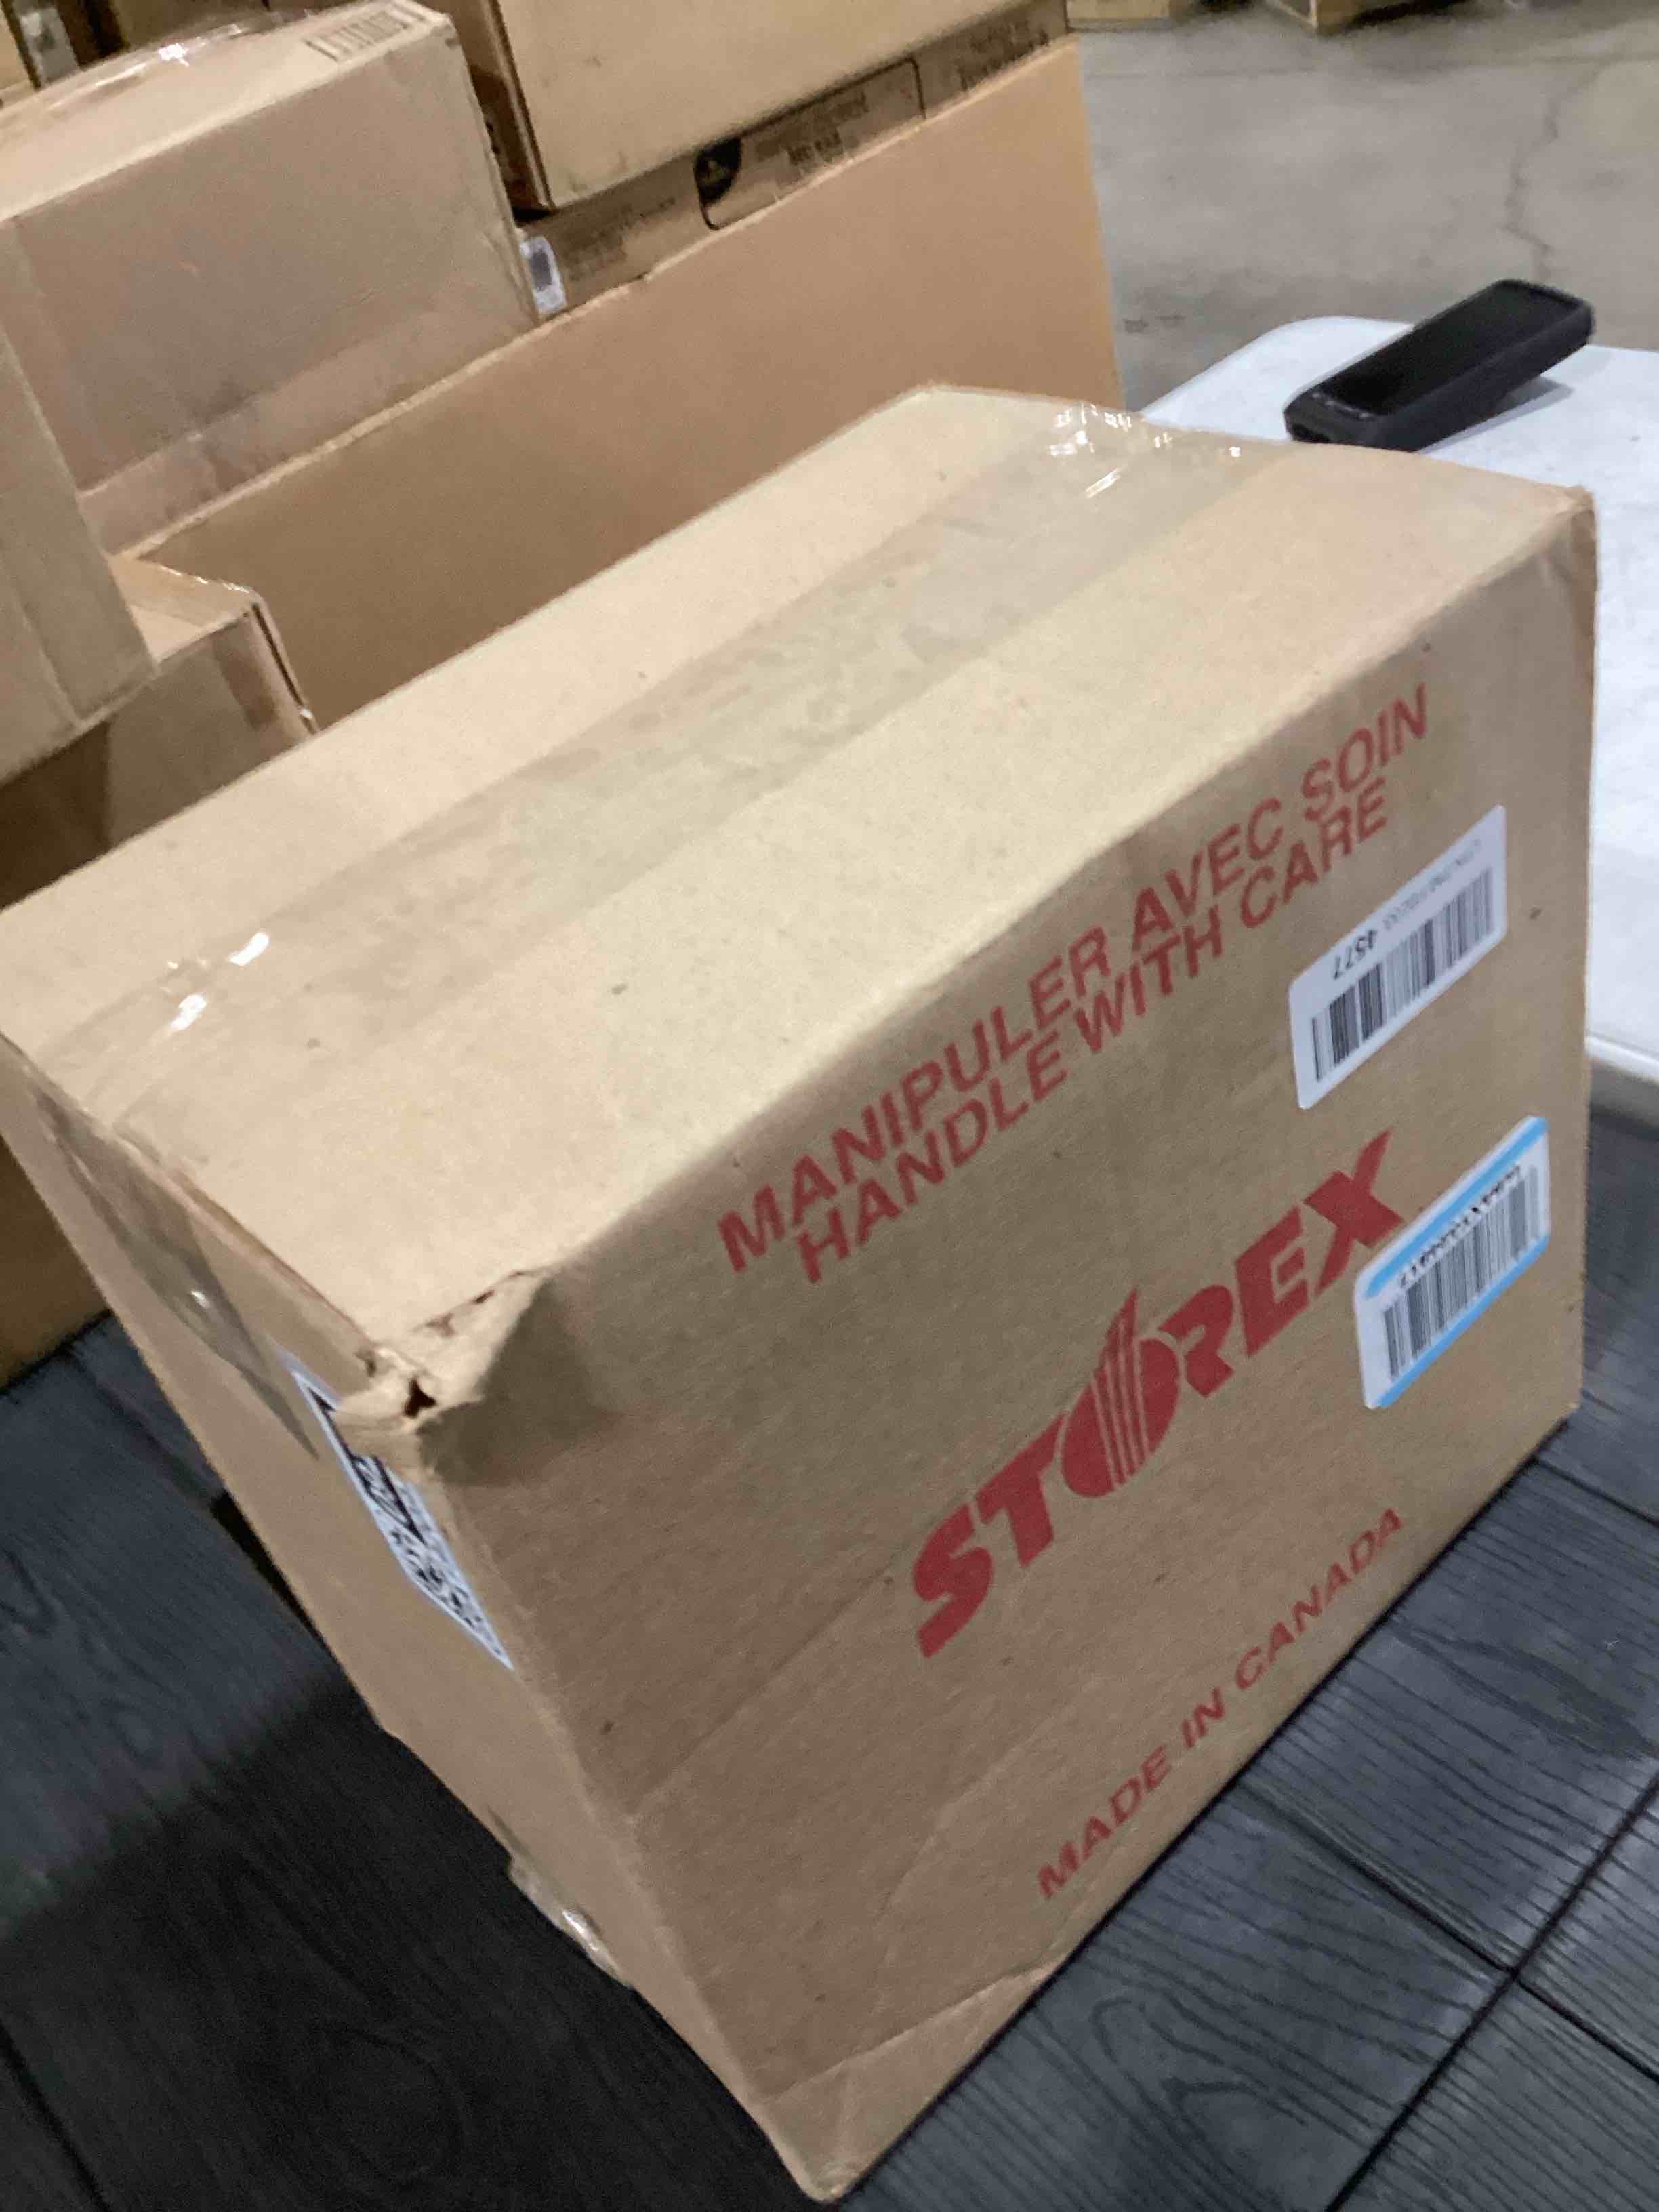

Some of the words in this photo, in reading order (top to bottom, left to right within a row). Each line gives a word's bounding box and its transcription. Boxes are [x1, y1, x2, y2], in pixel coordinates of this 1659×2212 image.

[718, 928, 1109, 1271] MANIPULER
[1132, 800, 1279, 950] AVEC
[1304, 686, 1427, 819] SOIN
[798, 1034, 1066, 1281] HANDLE
[1076, 911, 1221, 1052] WITH
[1241, 779, 1386, 927] CARE
[913, 1129, 1404, 1657] STOREX
[1038, 1746, 1171, 1898] MADE
[1183, 1688, 1225, 1748] IN
[1235, 1509, 1404, 1689] CANADA
